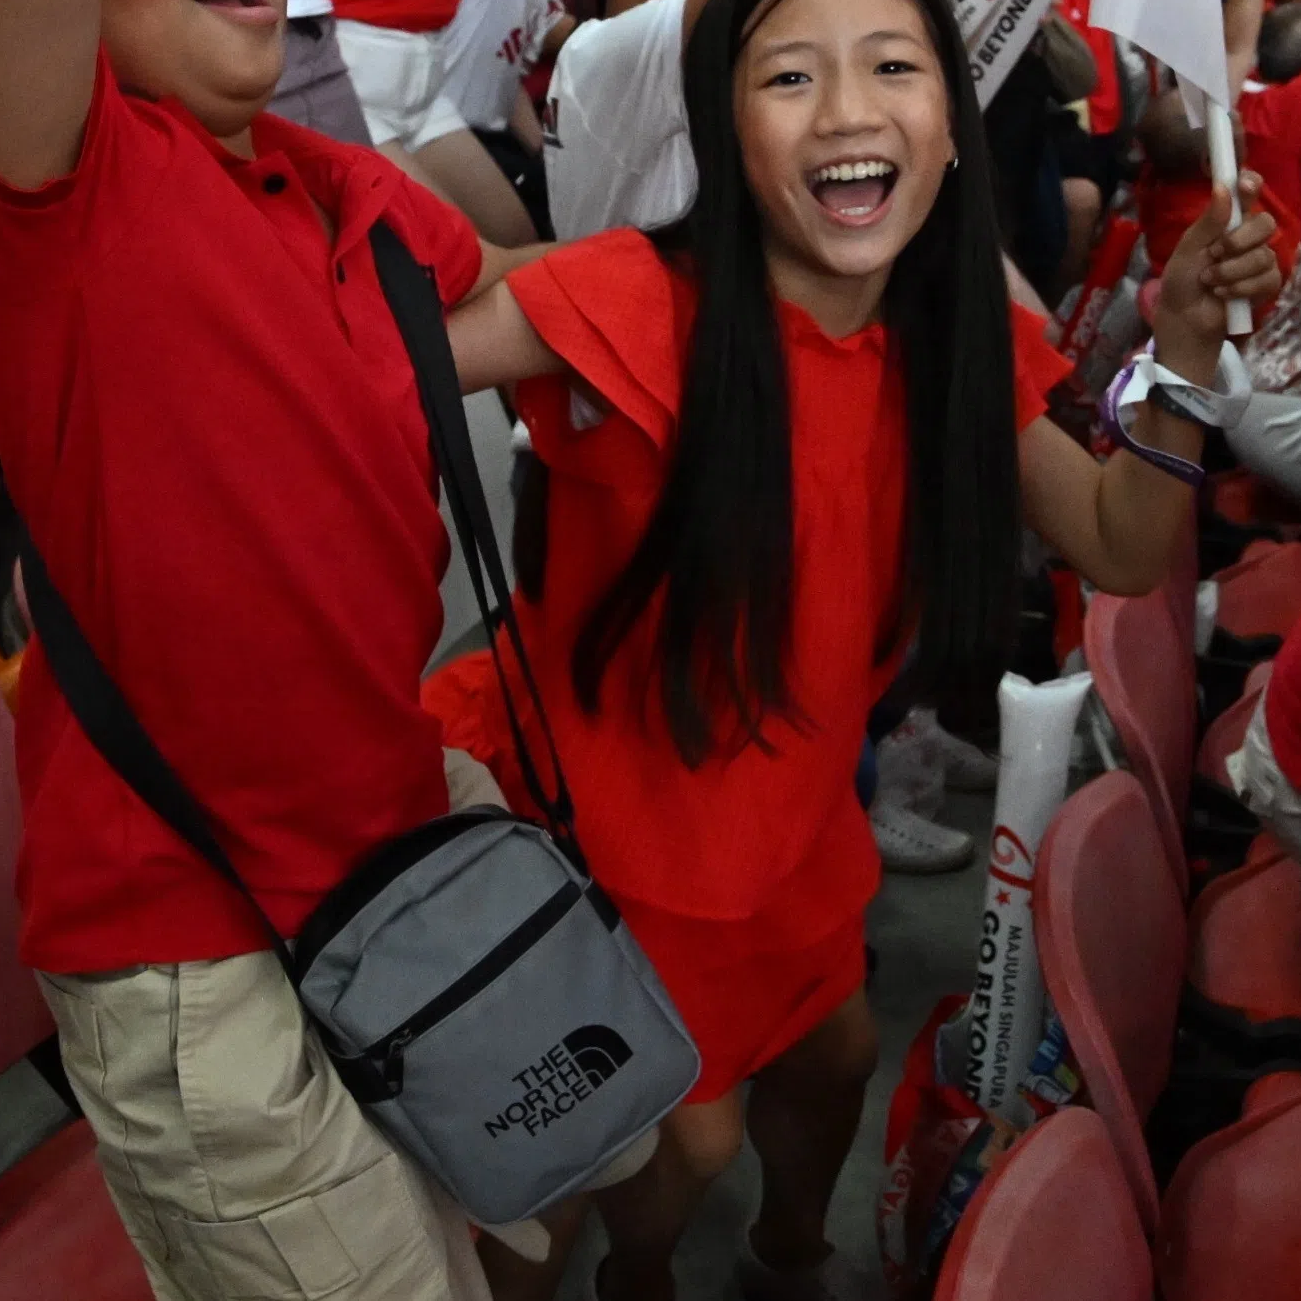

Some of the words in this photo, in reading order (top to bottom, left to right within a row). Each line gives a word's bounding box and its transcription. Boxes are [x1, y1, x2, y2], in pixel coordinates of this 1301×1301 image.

[979, 910, 1000, 965] GO
[1002, 925, 1023, 1008] MAJULAH
[512, 1044, 569, 1090] THE
[989, 1012, 1014, 1109] SINGAPURA
[484, 1061, 581, 1139] NORTH
[523, 1078, 593, 1137] FACE
